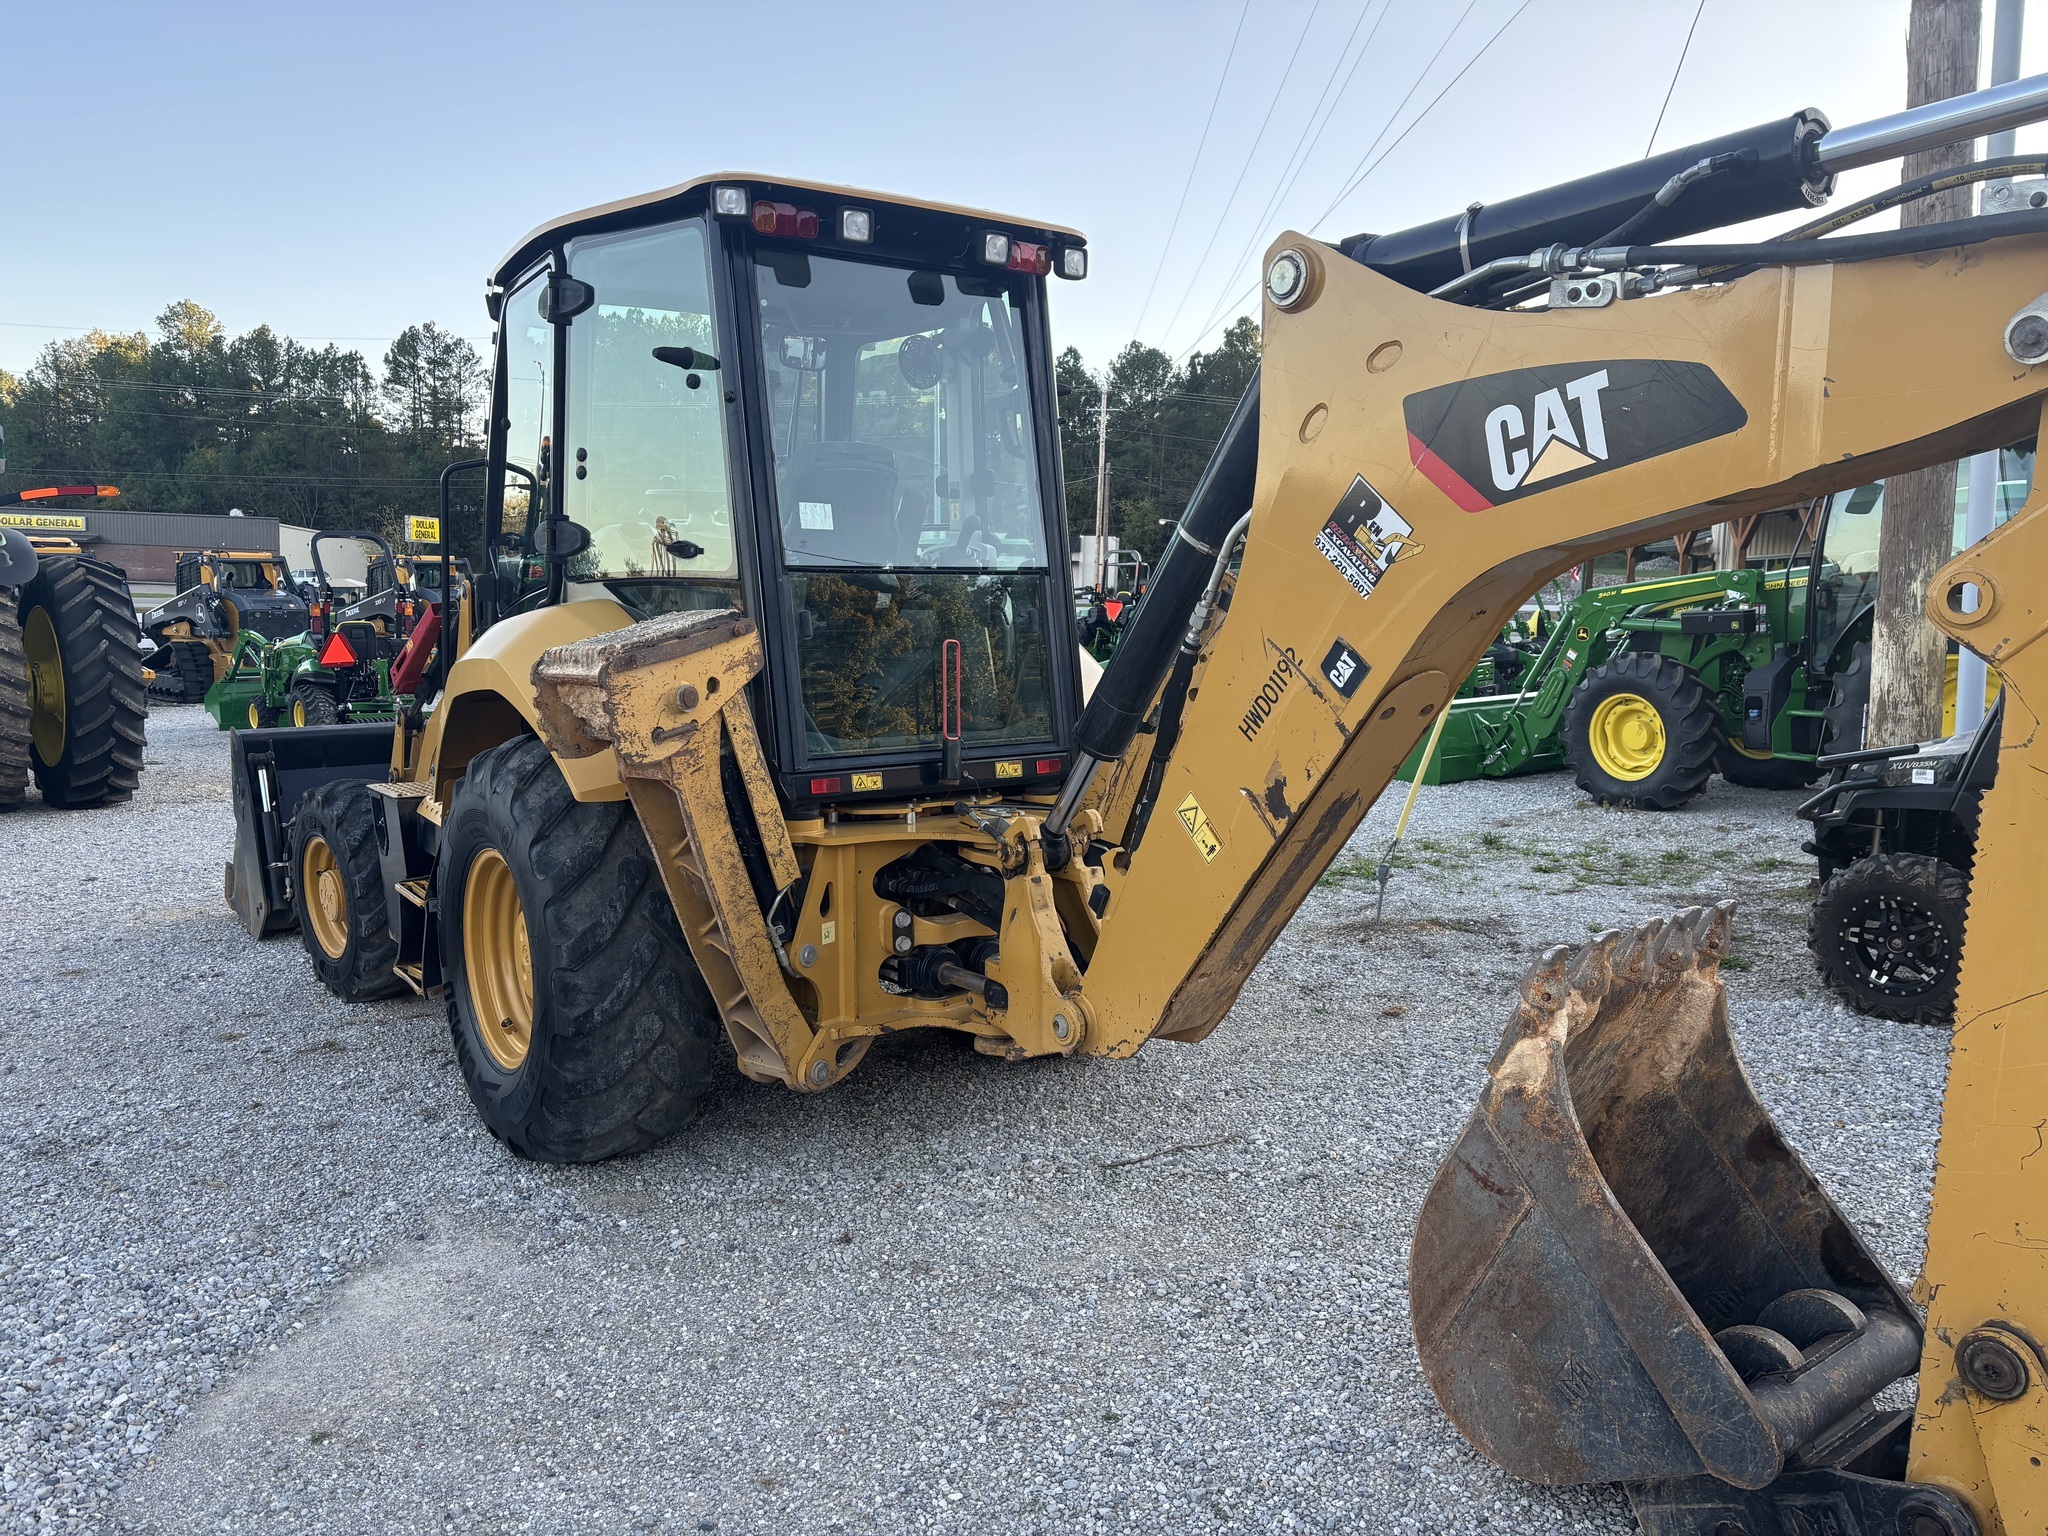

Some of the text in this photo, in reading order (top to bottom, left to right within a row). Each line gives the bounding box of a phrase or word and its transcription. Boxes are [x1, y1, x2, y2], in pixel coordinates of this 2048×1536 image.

[1484, 369, 1610, 492] CAT
[36, 518, 81, 528] GENERAL
[415, 520, 436, 530] DOLLAR
[414, 529, 437, 540] GENERAL
[1324, 528, 1377, 583] EXCAVATING
[1313, 537, 1372, 599] 931-220-5807
[1764, 582, 1783, 590] OHN
[151, 608, 165, 619] DEERE
[345, 606, 360, 618] DEERE
[1329, 651, 1357, 689] CAT
